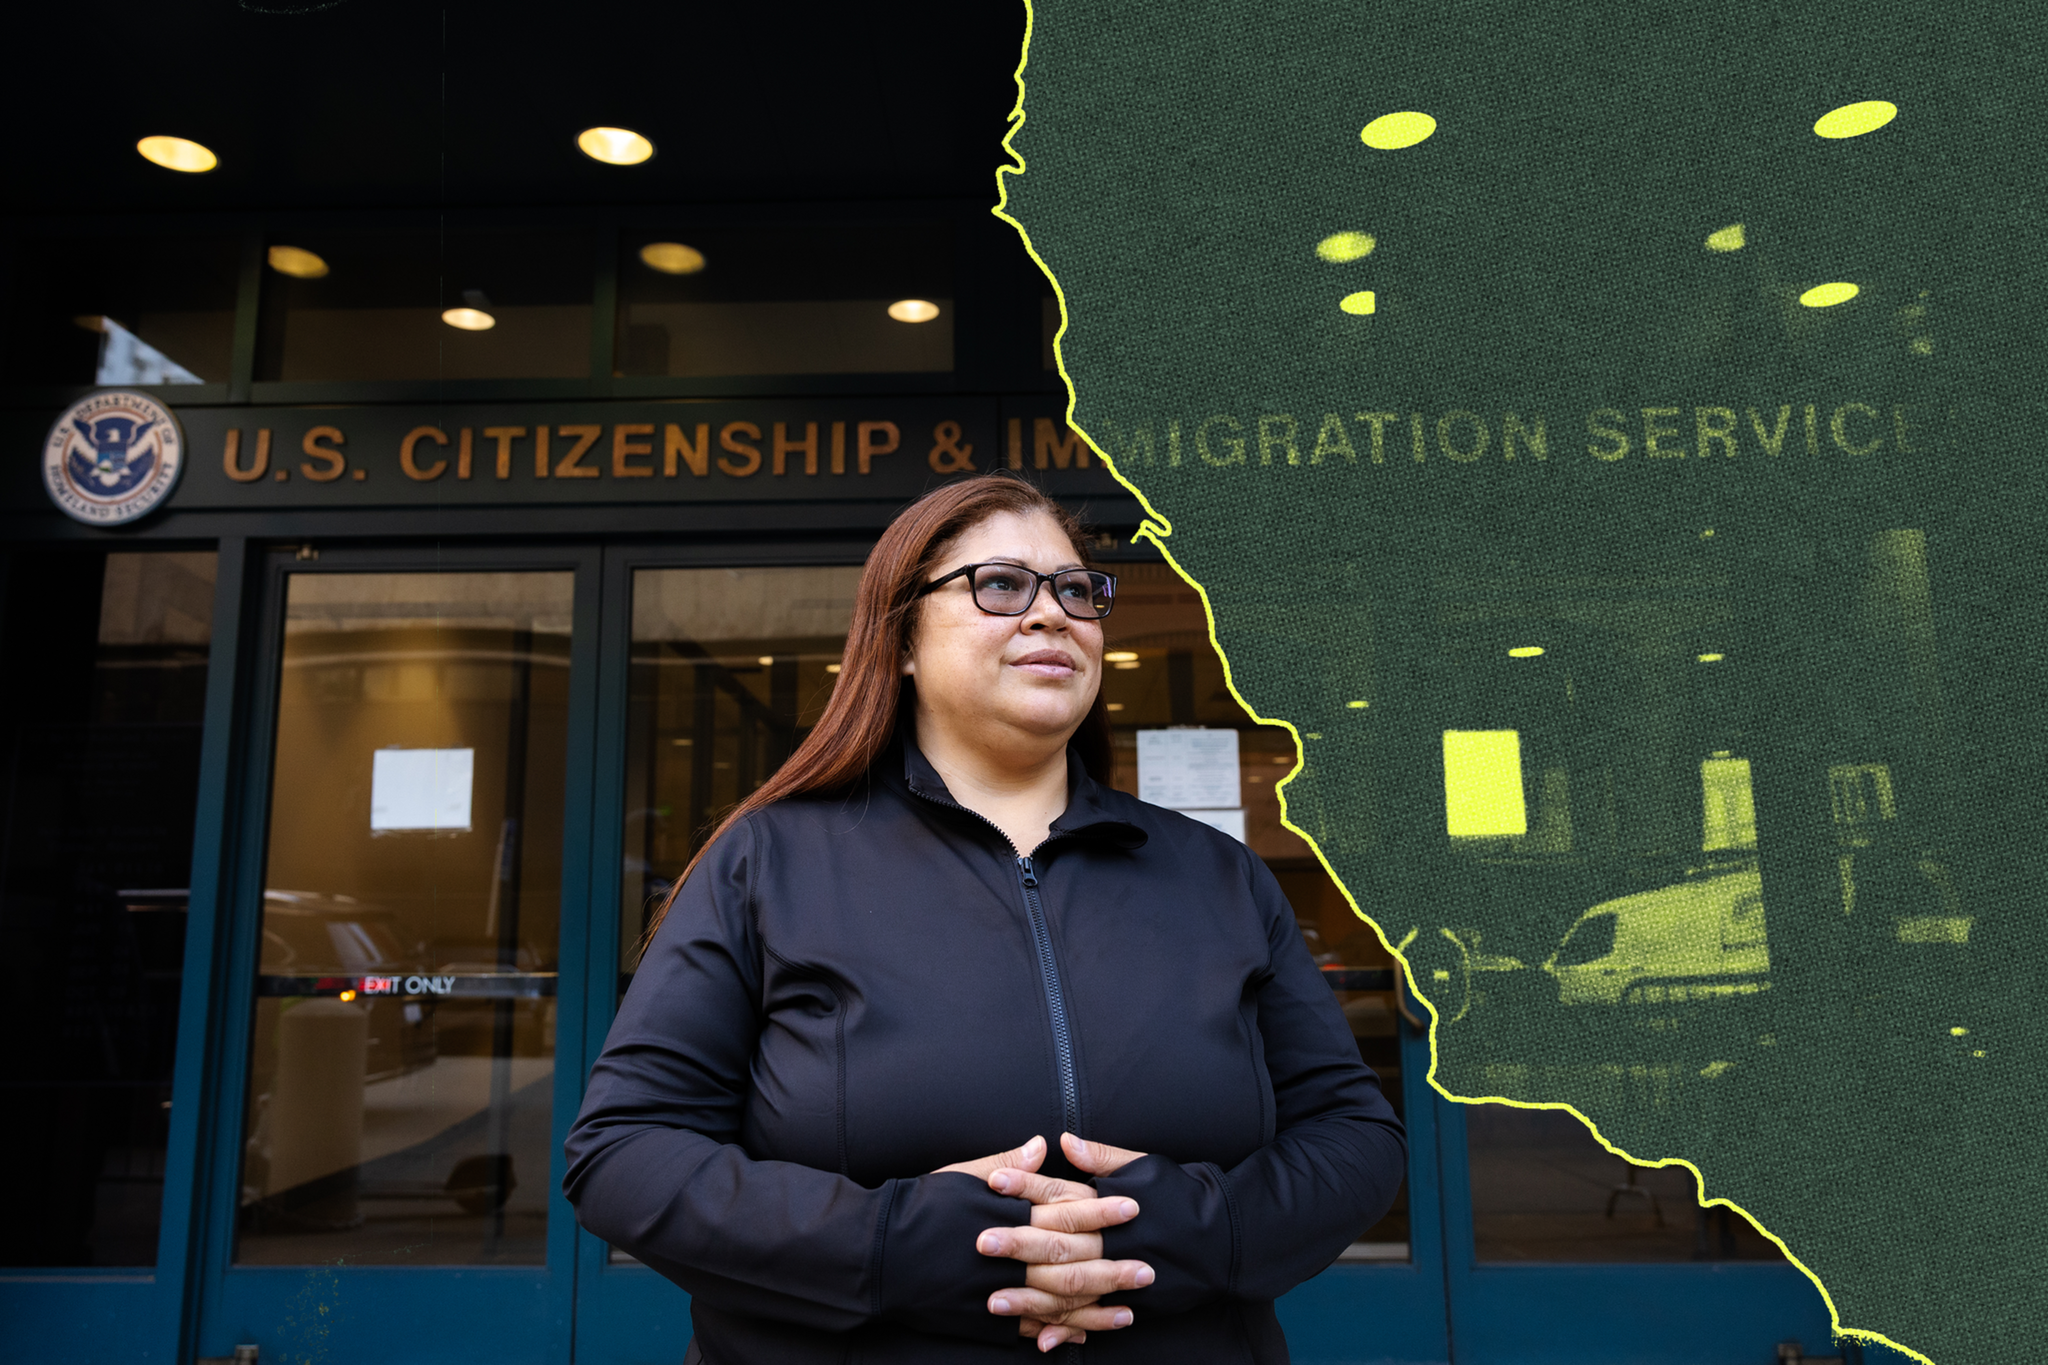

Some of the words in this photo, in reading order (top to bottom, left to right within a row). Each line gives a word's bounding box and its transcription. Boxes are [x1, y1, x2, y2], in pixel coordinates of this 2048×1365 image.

[222, 425, 366, 482] U.S.
[400, 420, 900, 480] CITIZENSHIP
[928, 420, 975, 475] &
[364, 976, 401, 994] EXIT
[404, 976, 455, 994] ONLY
